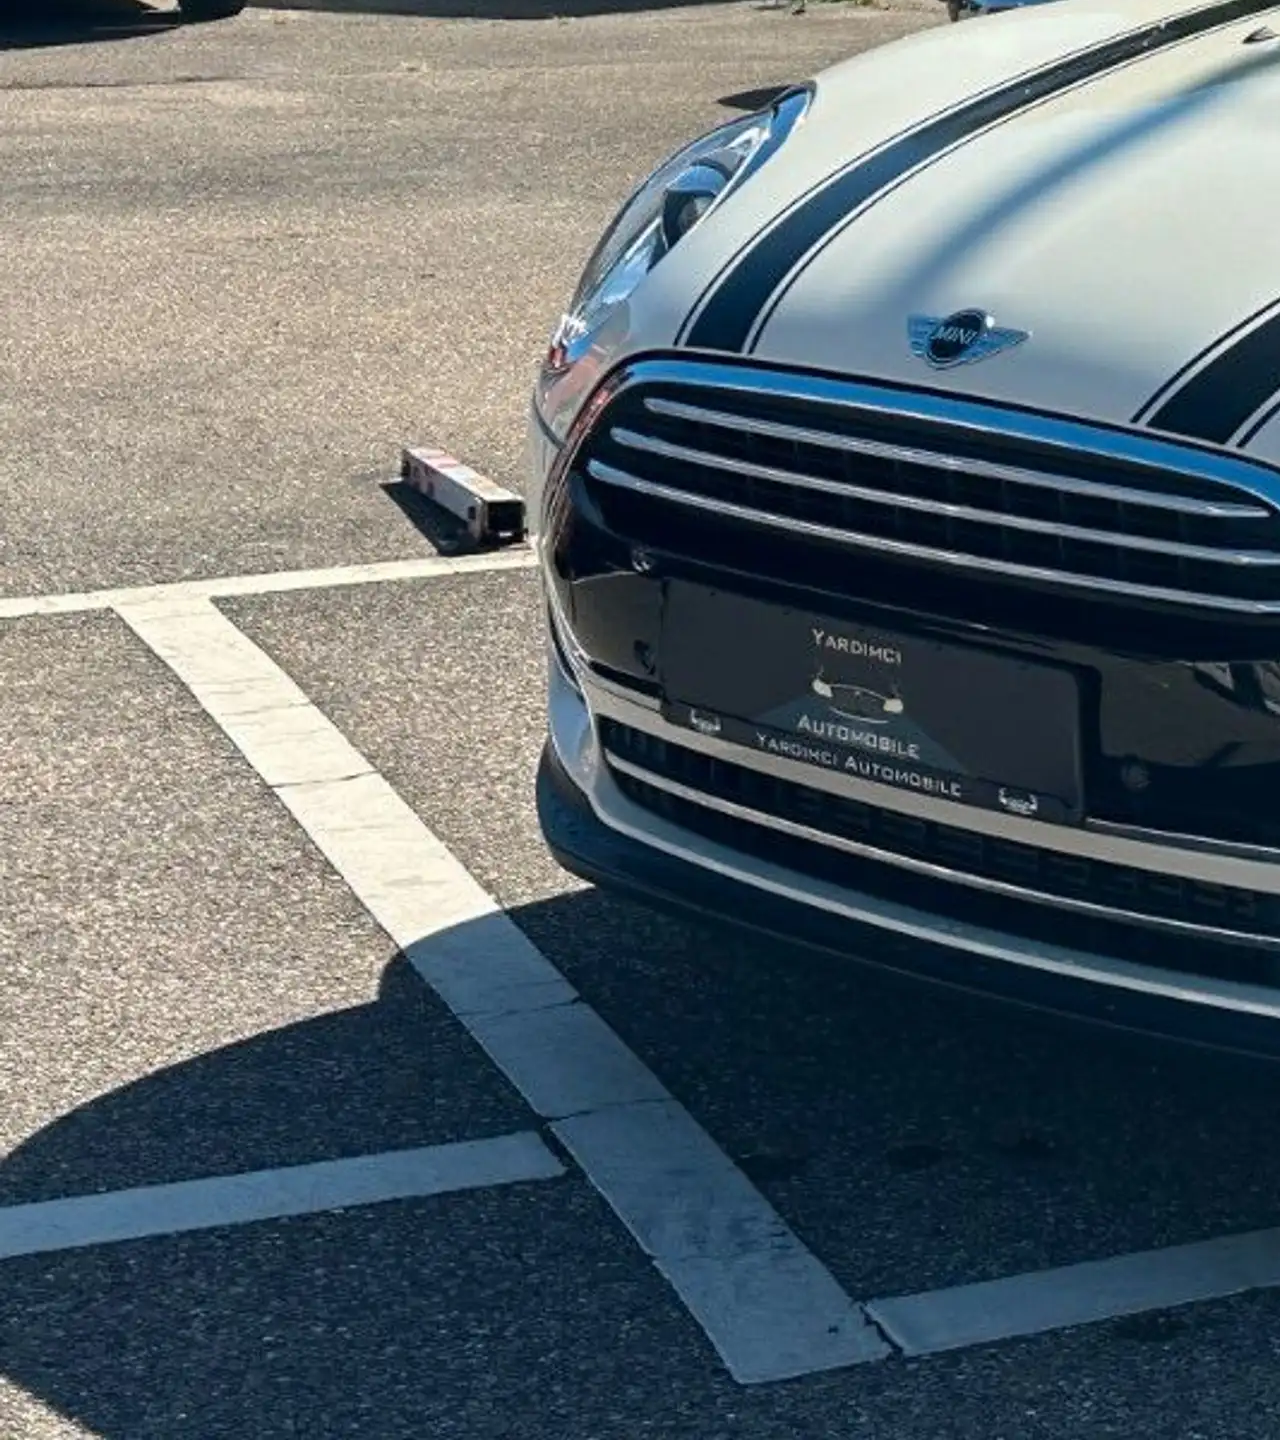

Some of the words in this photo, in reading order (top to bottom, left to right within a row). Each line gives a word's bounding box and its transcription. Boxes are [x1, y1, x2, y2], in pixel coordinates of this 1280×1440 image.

[930, 324, 979, 345] MINI
[810, 627, 903, 667] YARDIMCI
[795, 713, 922, 760] AUTOMOBILE
[755, 731, 839, 766] YARDIMCI
[844, 755, 963, 799] AUTOMOBILE
